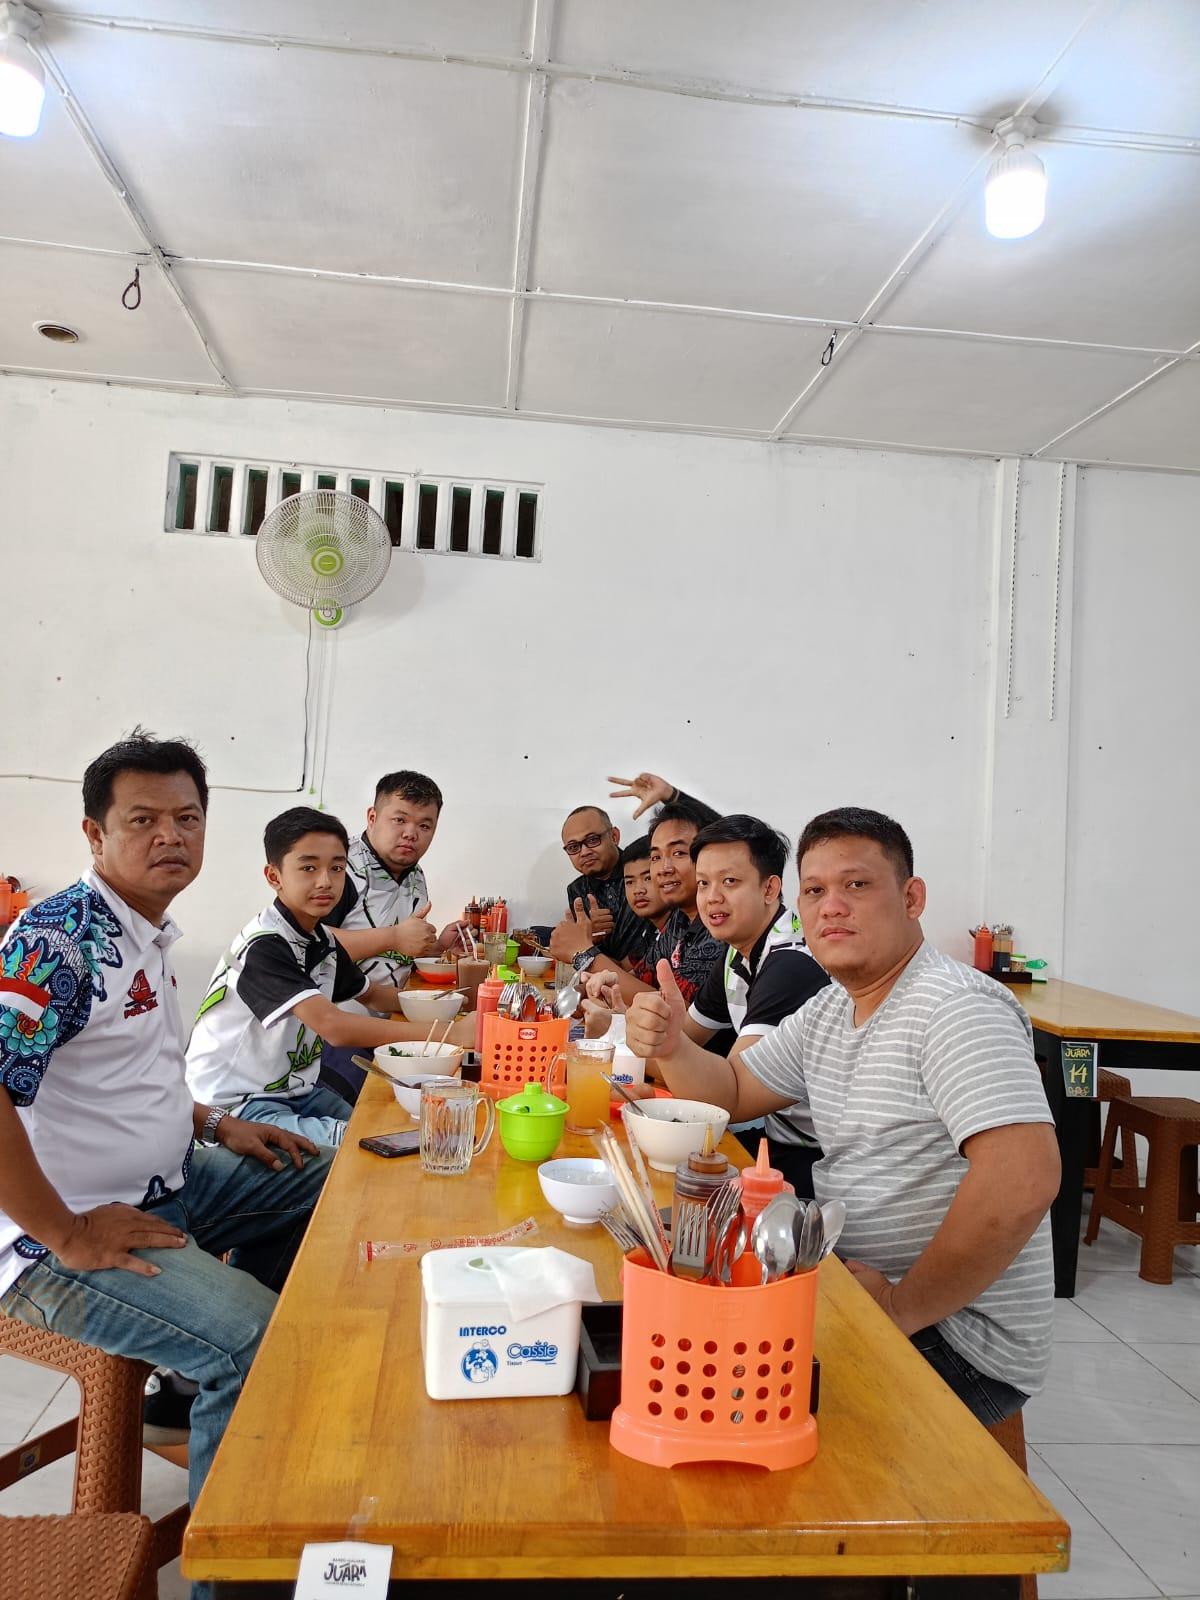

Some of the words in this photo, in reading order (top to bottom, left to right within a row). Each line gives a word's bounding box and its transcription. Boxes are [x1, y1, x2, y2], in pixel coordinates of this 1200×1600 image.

[1065, 1048, 1090, 1058] JUARA
[1069, 1063, 1088, 1083] 14
[459, 1325, 507, 1337] INTERCO
[507, 1341, 558, 1359] Cassie
[324, 1562, 367, 1582] JUARA
